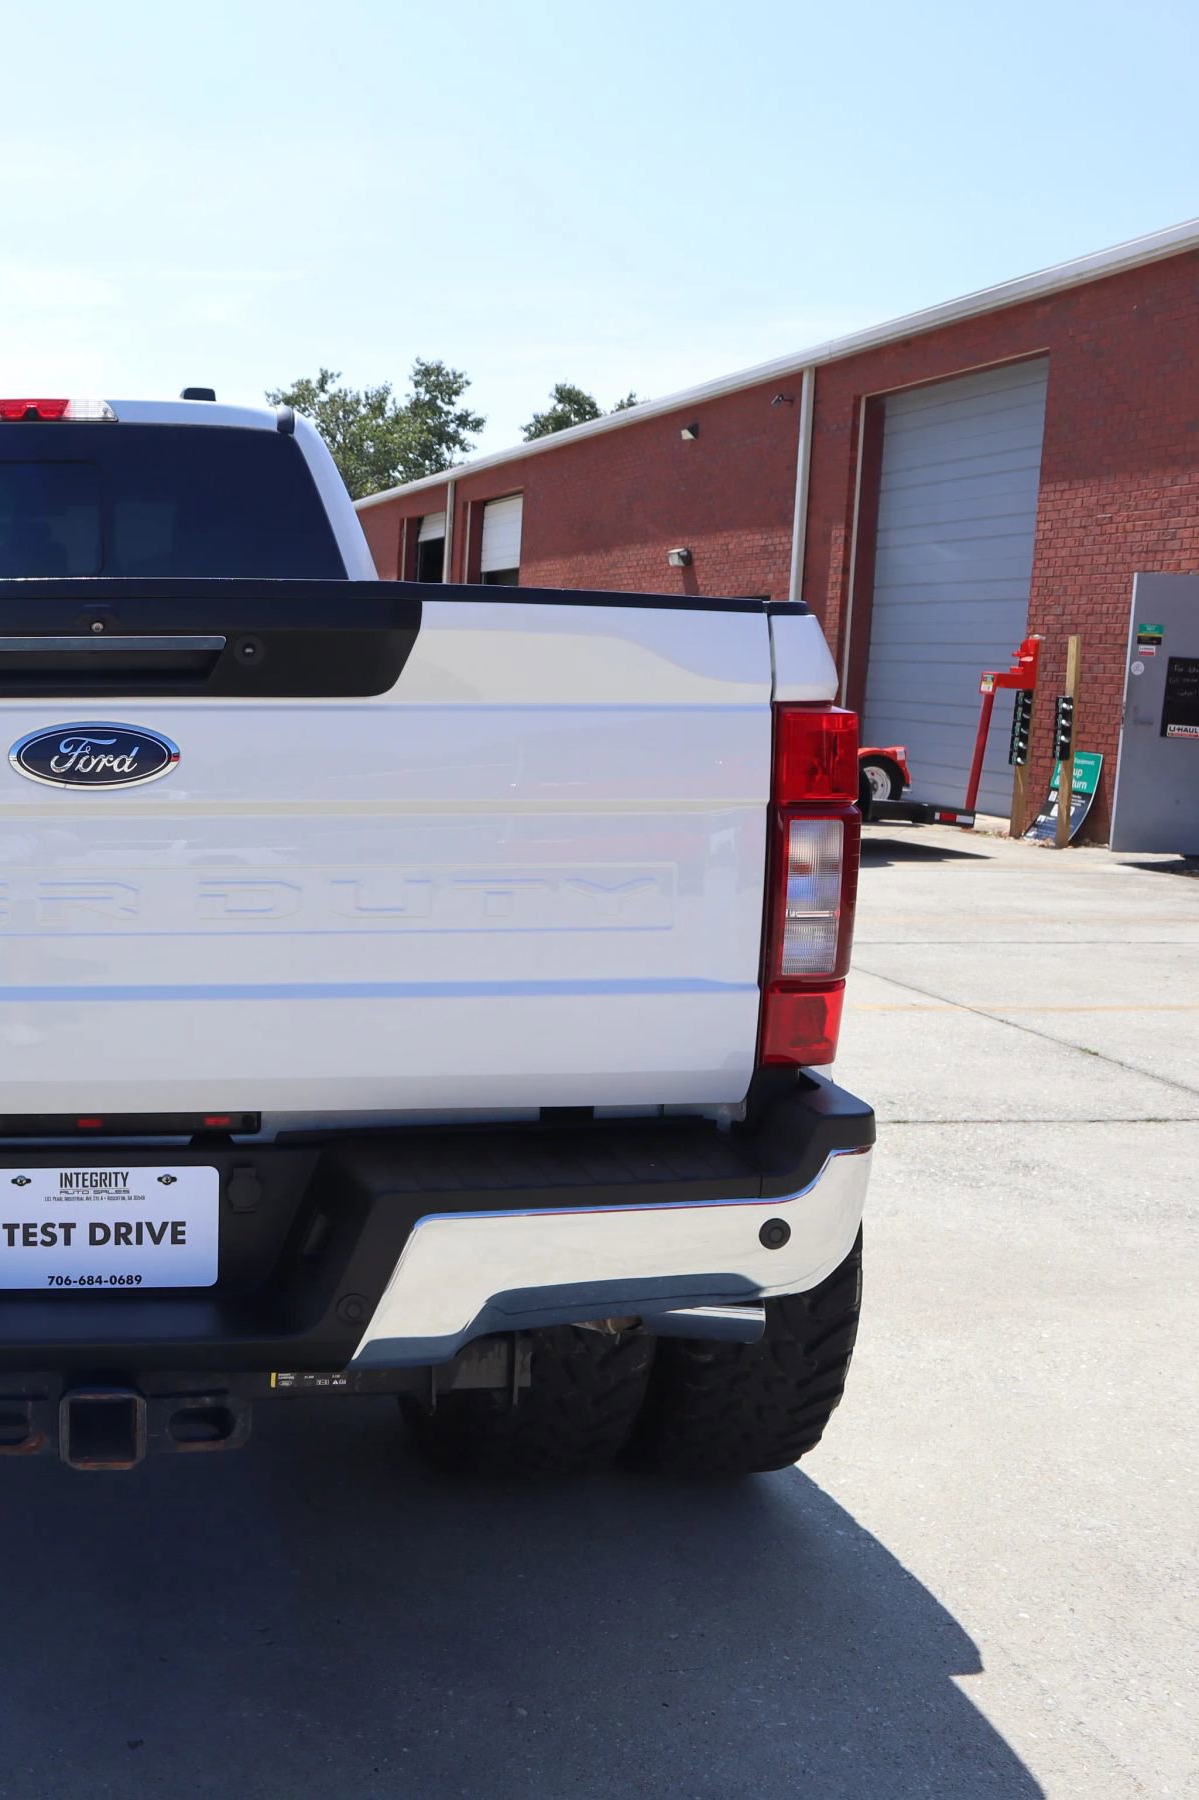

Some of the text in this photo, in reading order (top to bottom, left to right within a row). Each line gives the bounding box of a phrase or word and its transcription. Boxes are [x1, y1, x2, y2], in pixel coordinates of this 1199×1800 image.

[1169, 725, 1199, 734] U-HAUL
[50, 736, 139, 773] Ford
[197, 876, 658, 921] DUTY
[59, 1171, 129, 1188] INTEGRITY
[2, 1221, 187, 1247] TEST DRIVE
[47, 1274, 143, 1287] 706-684-0689
